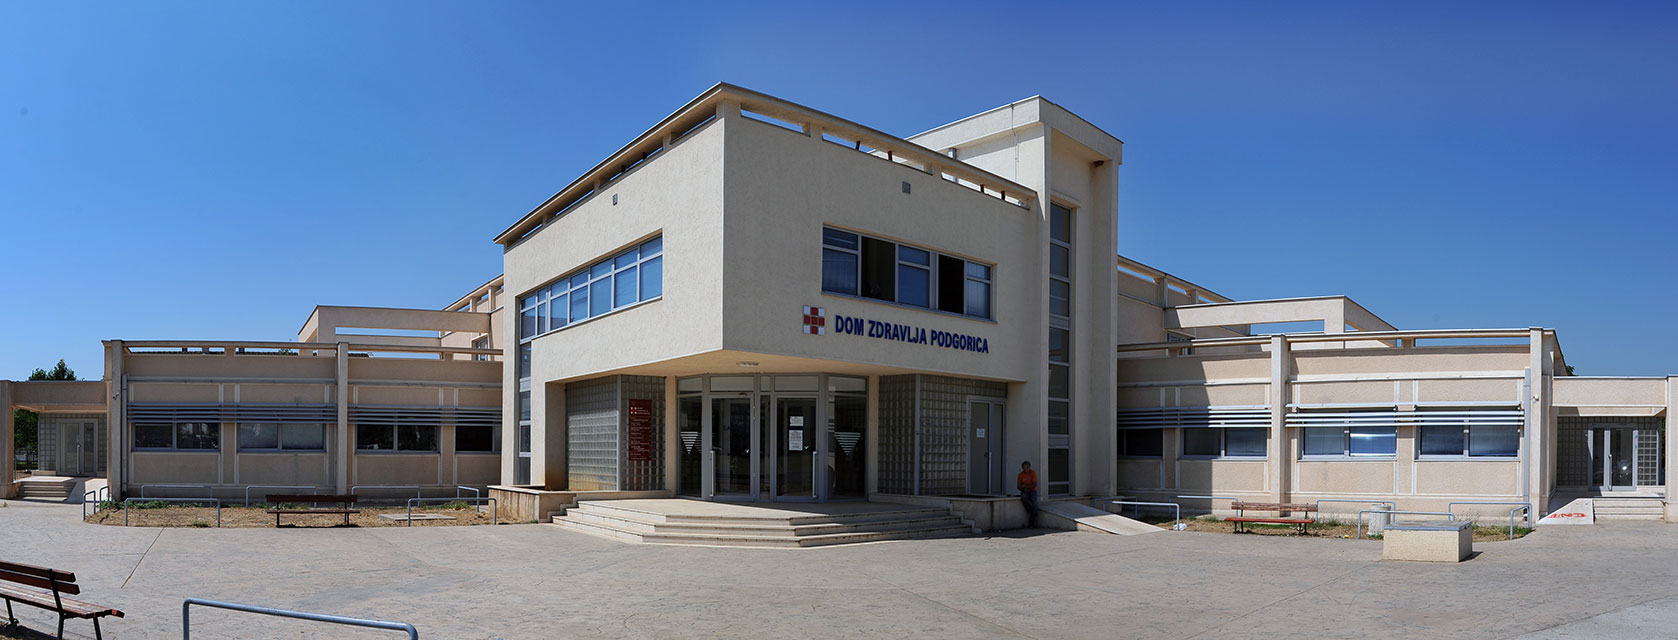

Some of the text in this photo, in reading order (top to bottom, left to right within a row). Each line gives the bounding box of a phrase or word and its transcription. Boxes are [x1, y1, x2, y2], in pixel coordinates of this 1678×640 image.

[835, 315, 989, 353] DOM ZDRAVLJA PODGORICA
